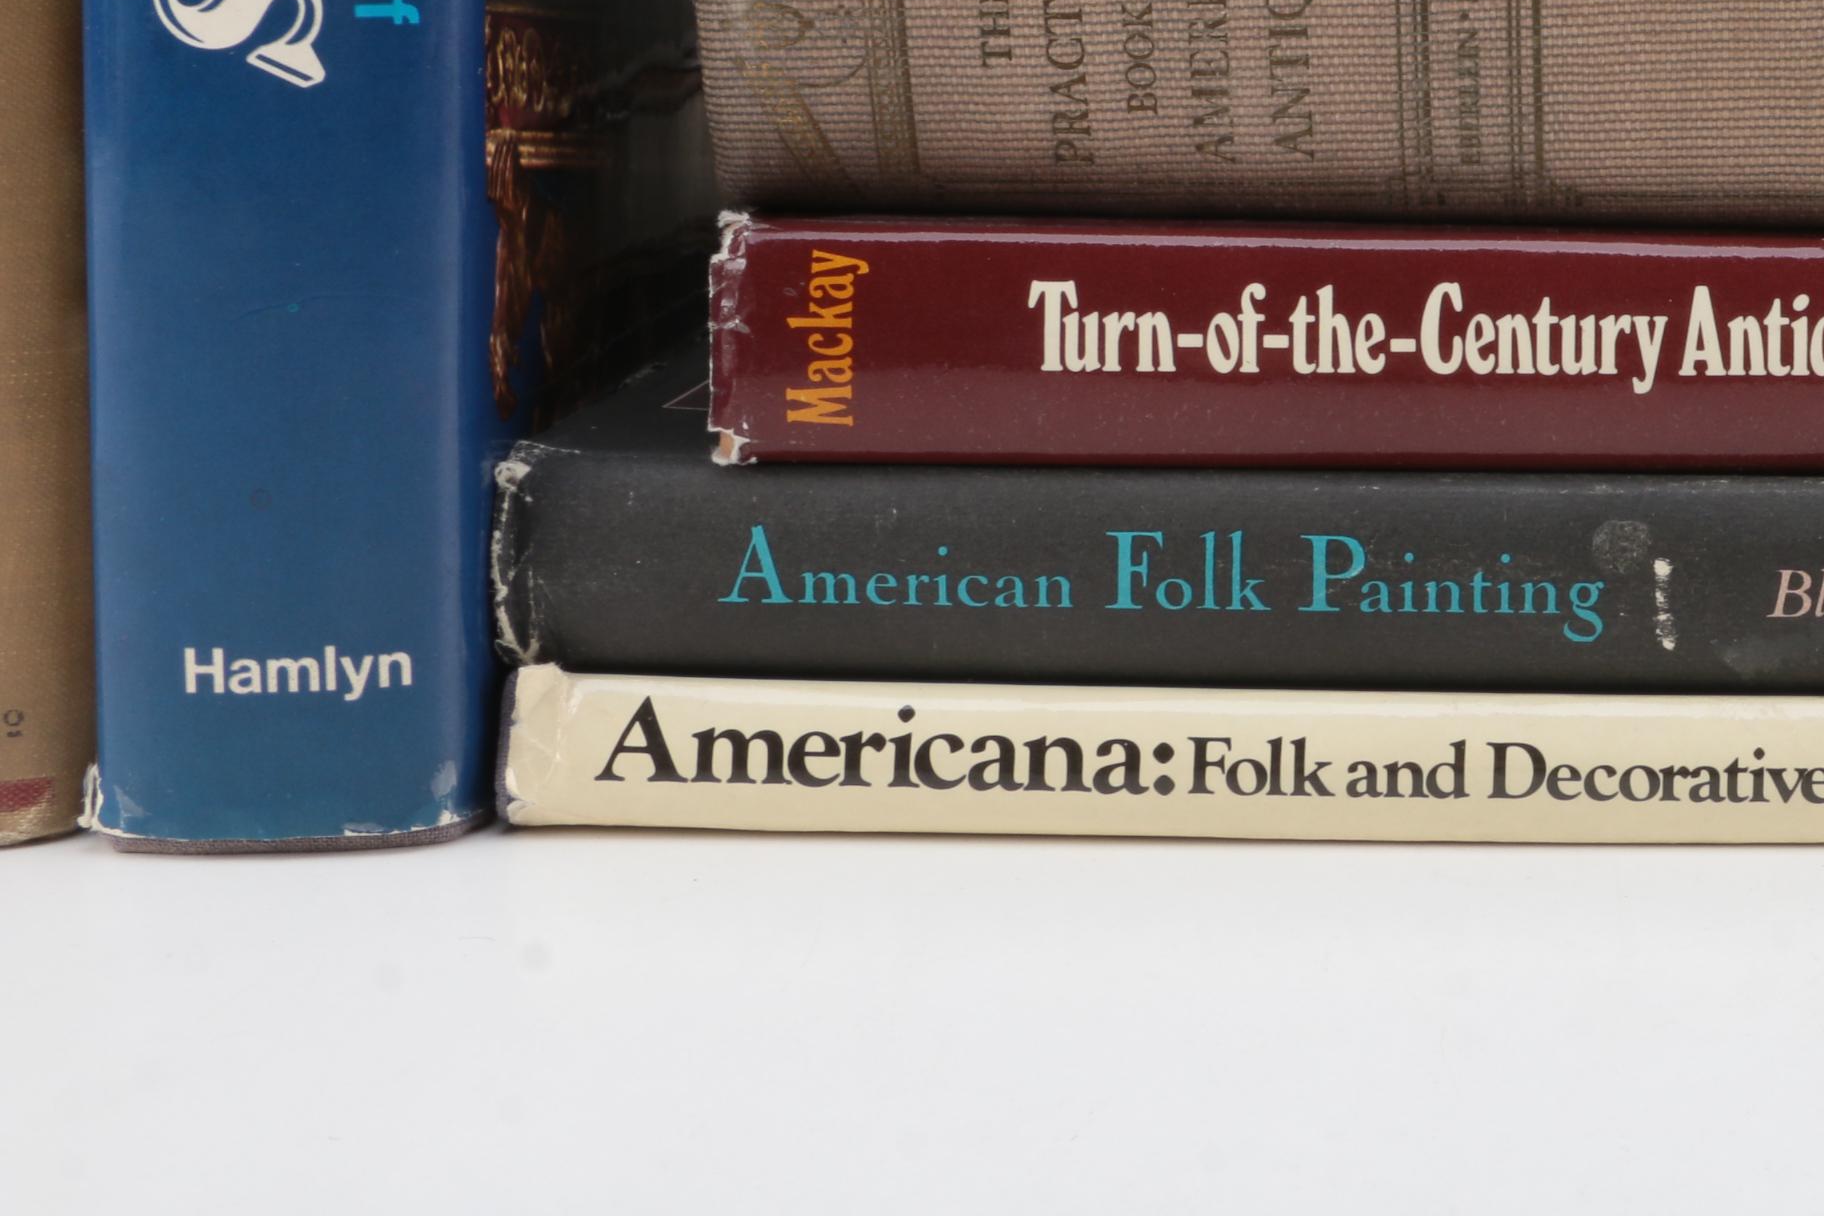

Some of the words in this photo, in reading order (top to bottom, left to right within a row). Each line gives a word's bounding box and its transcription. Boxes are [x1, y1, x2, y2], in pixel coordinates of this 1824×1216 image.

[1121, 2, 1158, 115] BOOK
[786, 249, 869, 427] Mackay
[1028, 281, 1667, 394] Turn-of-the-Century
[717, 524, 1073, 609] American
[1105, 530, 1271, 611] Folk
[1300, 534, 1605, 642] Painting
[183, 646, 413, 702] Hamlyn
[595, 697, 1177, 796] Americana:
[1187, 737, 1335, 797] Folk
[1345, 741, 1466, 799] and
